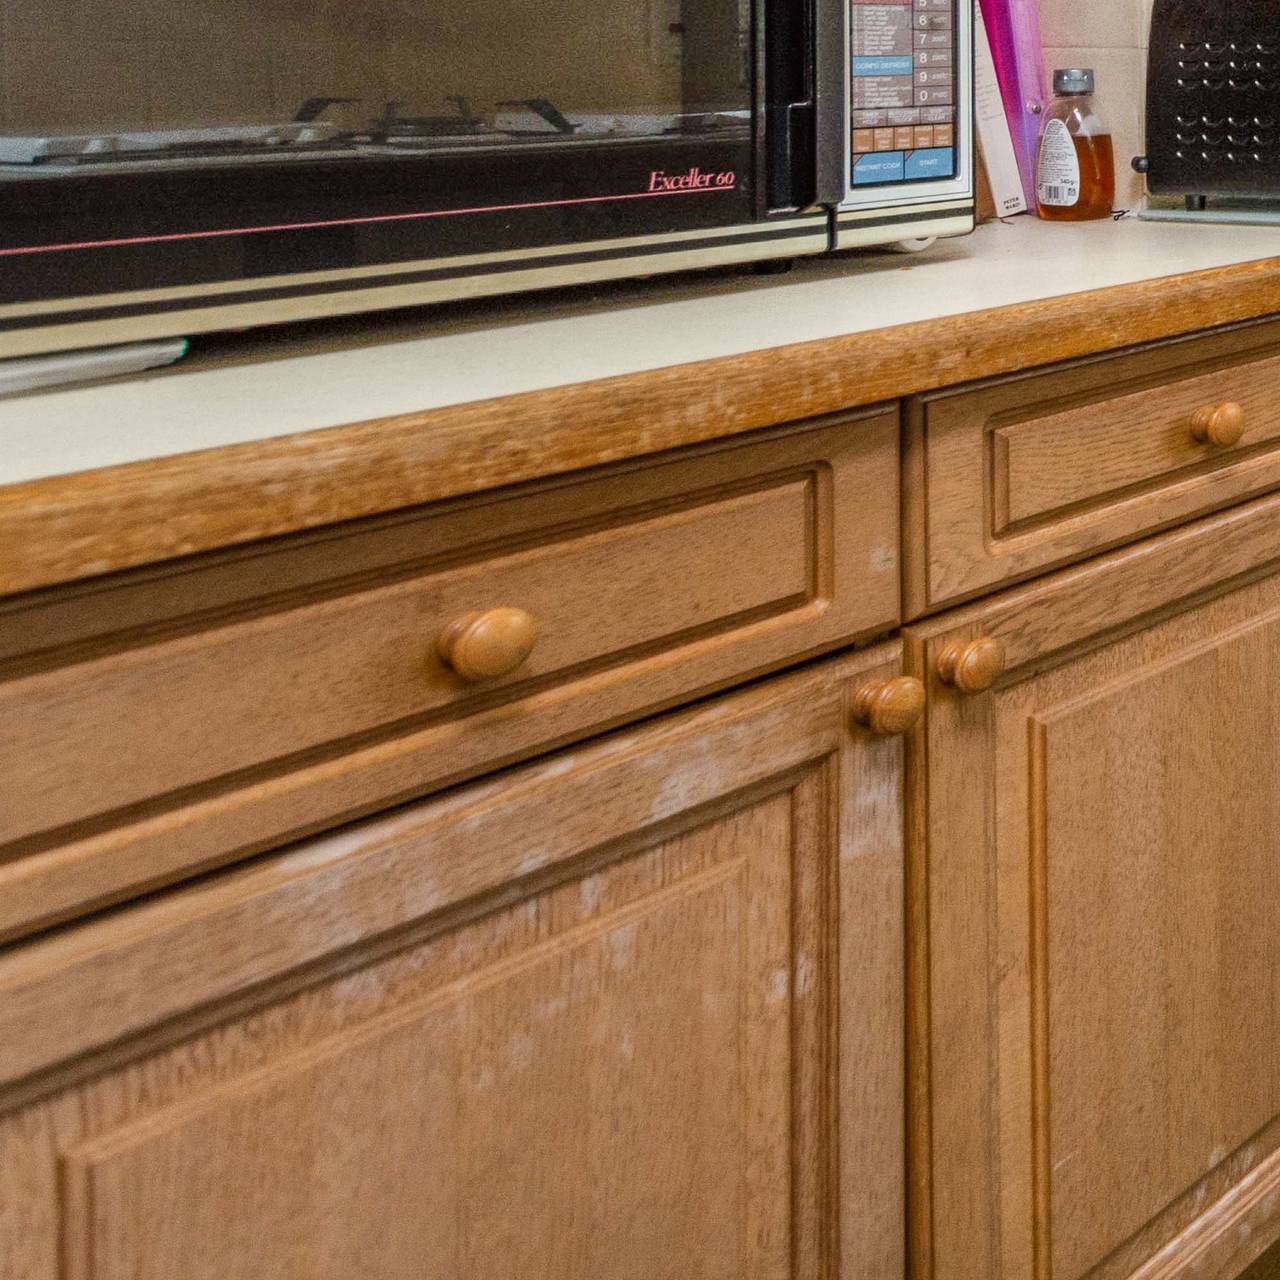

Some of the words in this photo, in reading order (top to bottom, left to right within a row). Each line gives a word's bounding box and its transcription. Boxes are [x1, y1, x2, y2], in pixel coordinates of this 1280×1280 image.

[919, 15, 927, 26] 6
[919, 33, 927, 44] 7
[919, 52, 927, 63] 8
[919, 71, 927, 82] 9
[919, 90, 928, 101] 0
[648, 167, 714, 192] Exceller
[716, 171, 736, 186] 60
